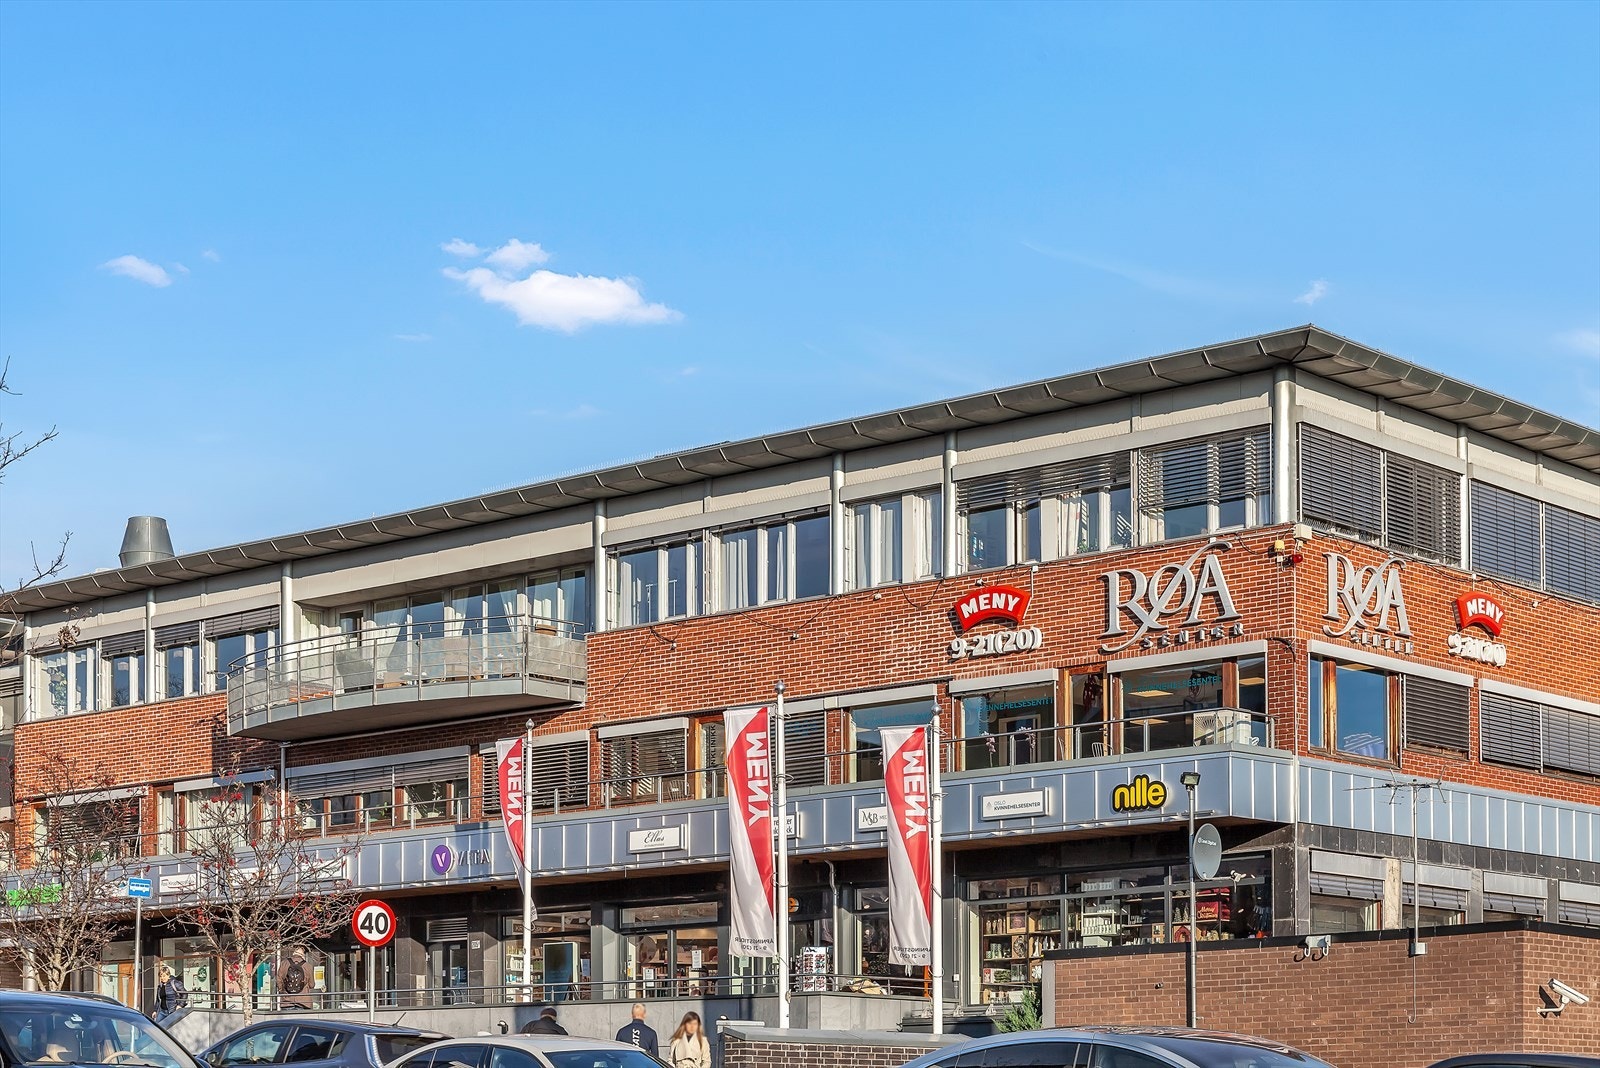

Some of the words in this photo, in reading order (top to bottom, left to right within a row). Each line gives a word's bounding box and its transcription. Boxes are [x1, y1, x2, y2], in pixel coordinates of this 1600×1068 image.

[960, 593, 1020, 619] MENY
[1098, 540, 1243, 652] RØA
[1322, 552, 1413, 637] RØA
[1466, 598, 1504, 624] MENY
[951, 627, 1043, 659] 9-21(20)
[1142, 622, 1245, 648] SENTER
[1113, 777, 1165, 810] nille
[360, 912, 389, 935] 40
[632, 1028, 640, 1048] ATS
